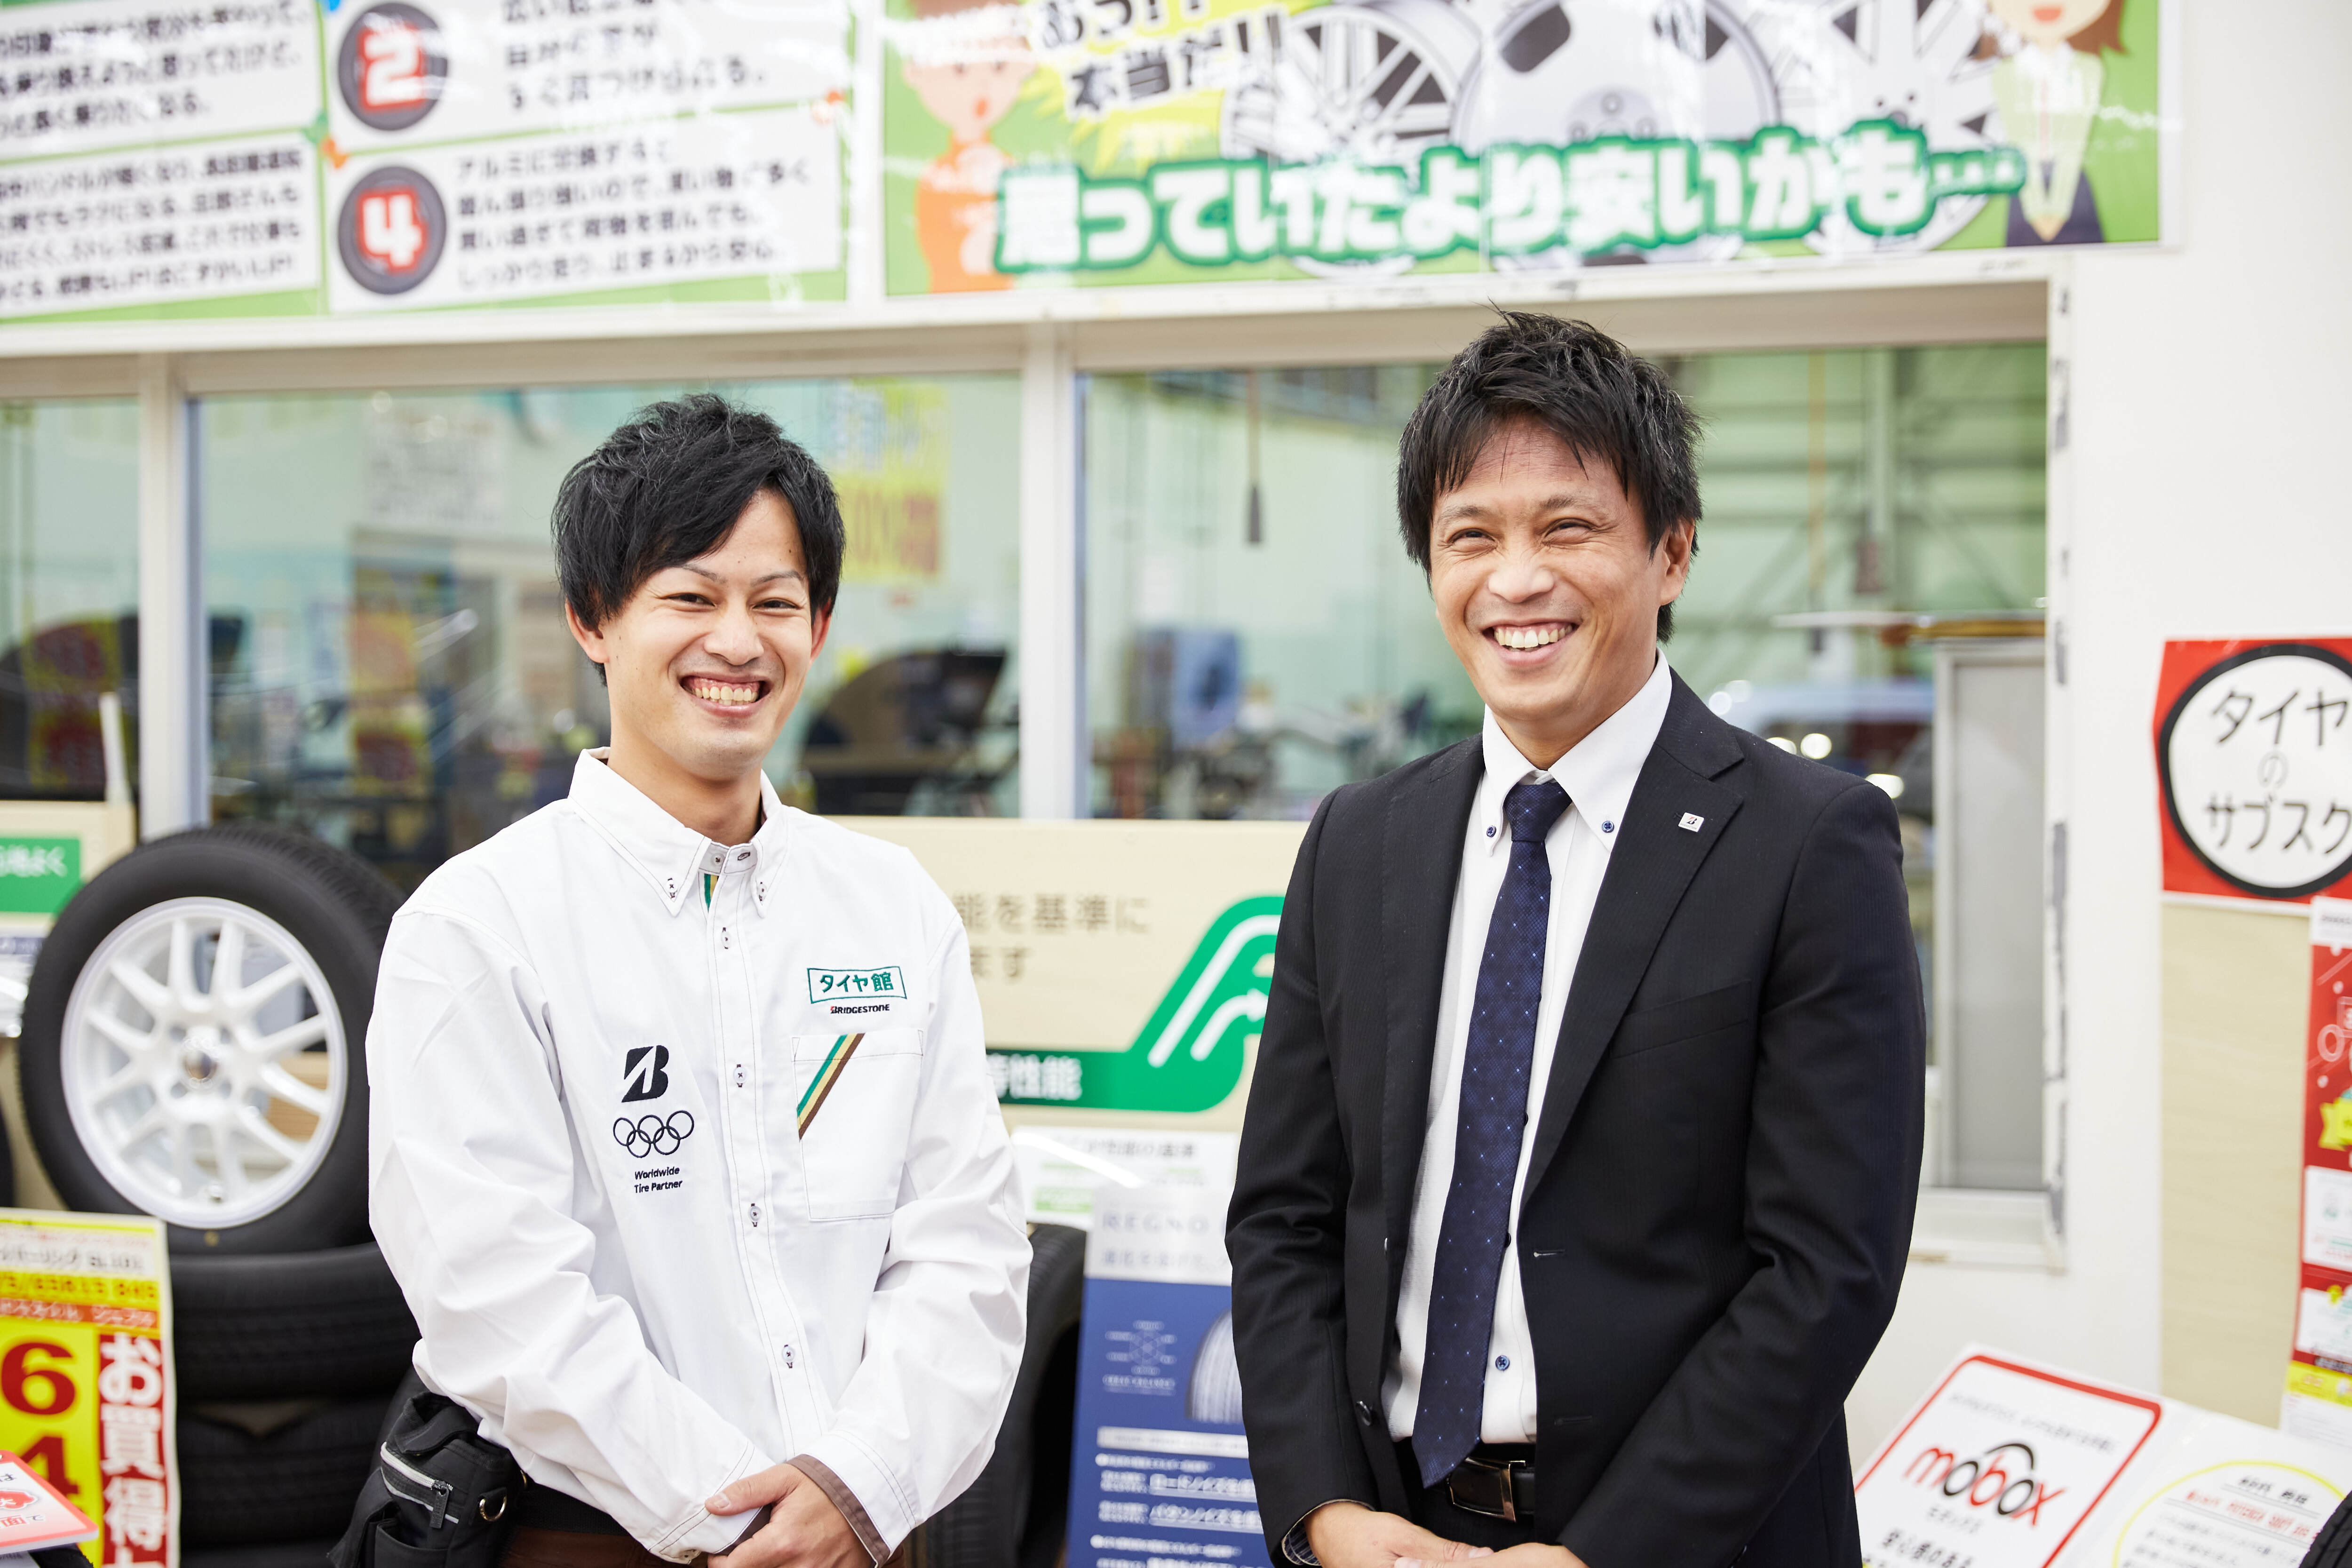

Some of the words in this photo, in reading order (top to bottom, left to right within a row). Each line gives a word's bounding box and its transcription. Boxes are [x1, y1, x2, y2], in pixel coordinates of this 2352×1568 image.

[360, 27, 427, 109] 2
[361, 193, 425, 268] 4
[2211, 689, 2349, 747] タイヤ
[2205, 795, 2352, 854] サブスク
[820, 971, 894, 993] タイヤ館
[830, 1004, 890, 1014] BRIDGESTONE
[634, 1184, 649, 1193] Tire
[651, 1180, 683, 1191] Partner
[635, 1166, 680, 1179] Worldwide
[1, 1343, 76, 1415] 6
[1904, 1447, 2066, 1526] mobox
